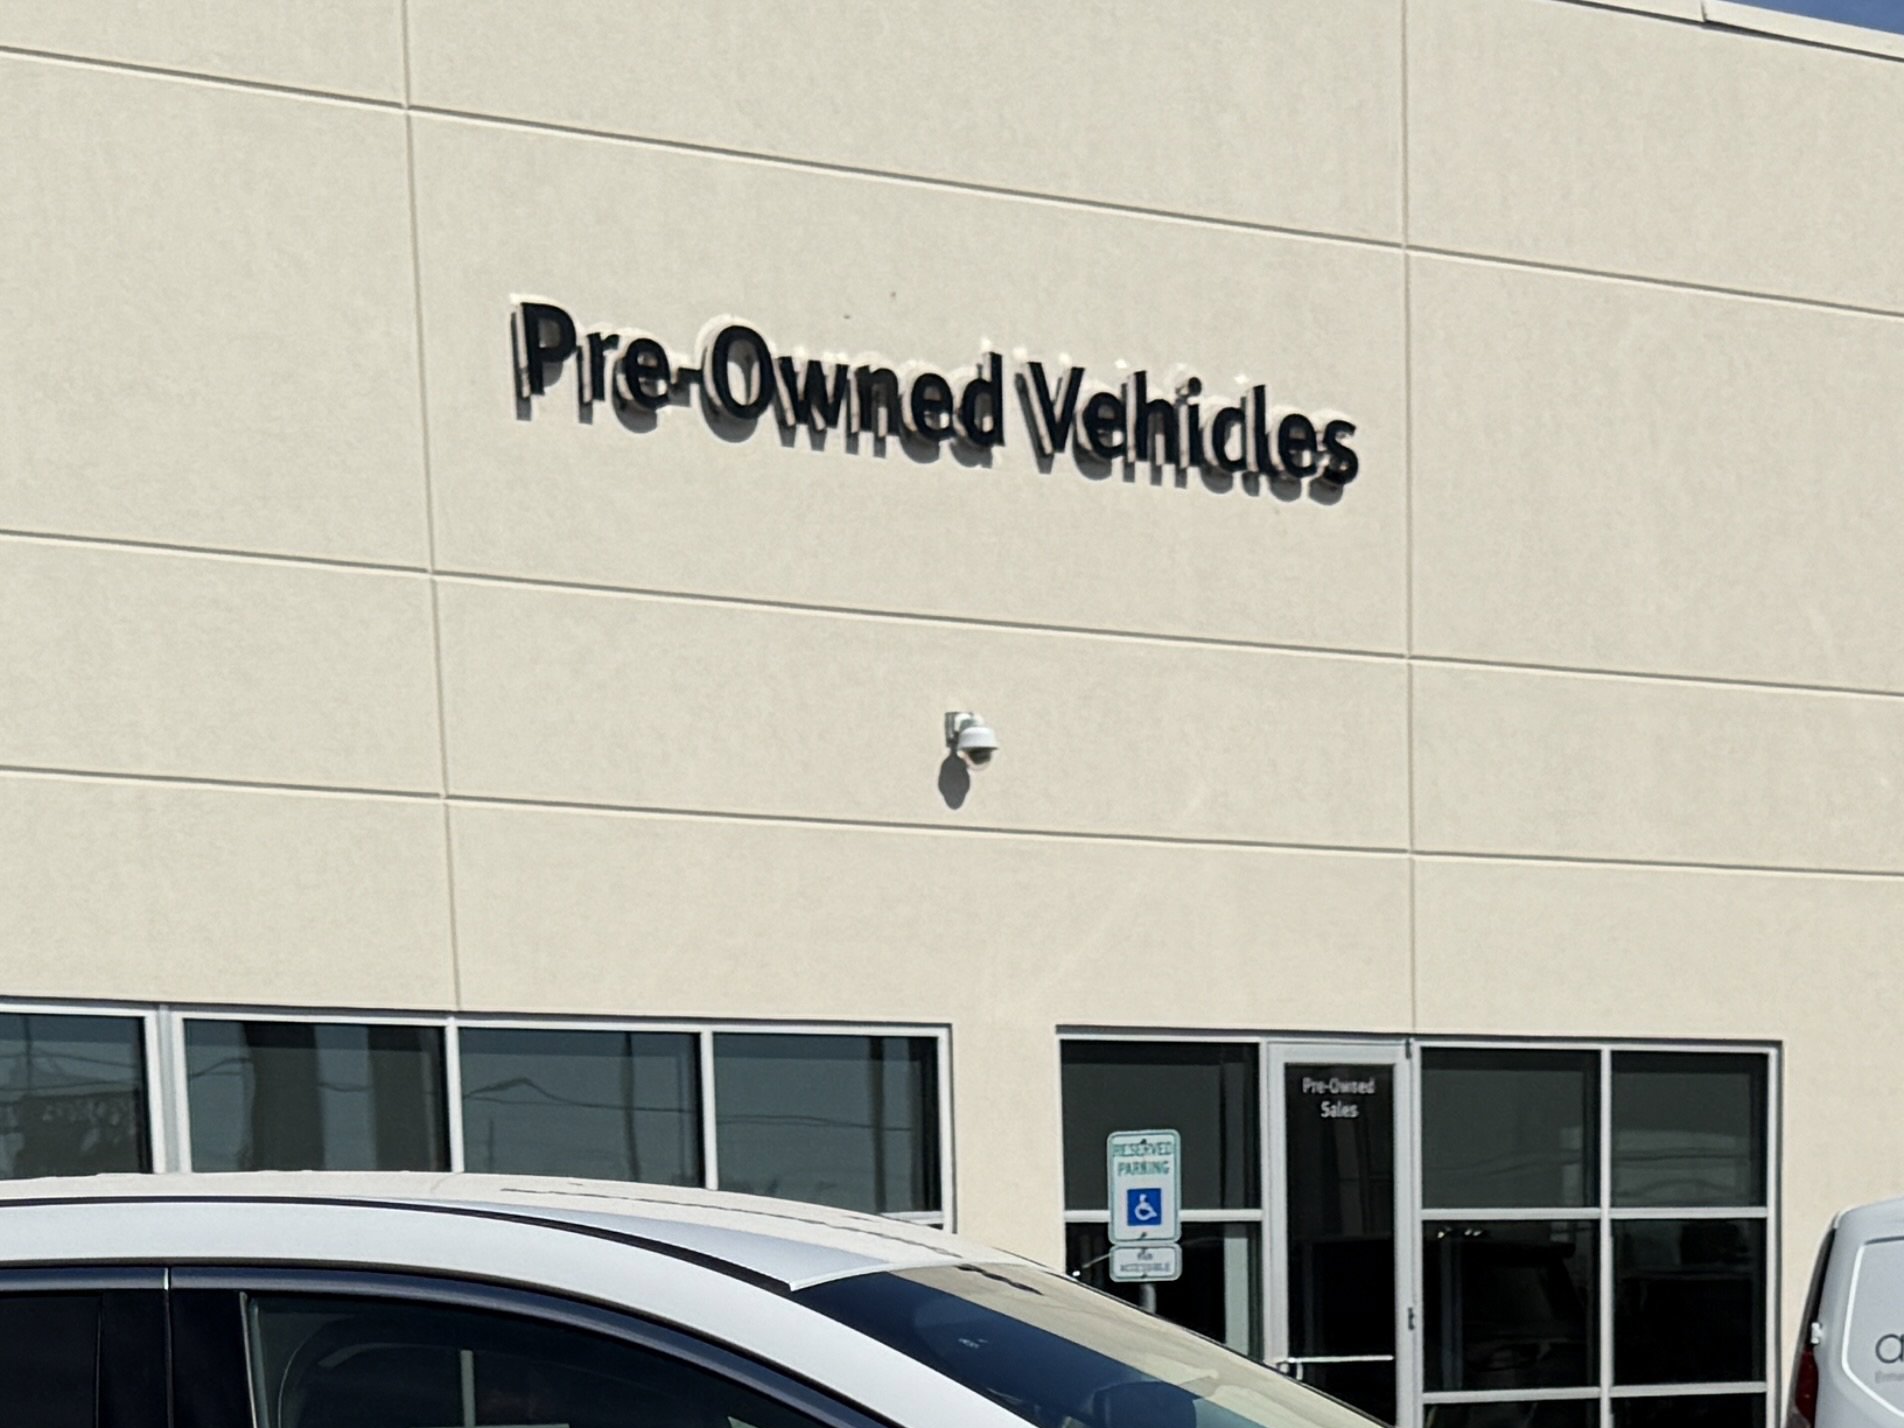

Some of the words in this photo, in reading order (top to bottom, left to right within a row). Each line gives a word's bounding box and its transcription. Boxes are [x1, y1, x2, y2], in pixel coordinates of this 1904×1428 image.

[510, 298, 1006, 458] Pre-Owned
[1014, 356, 1360, 496] Vehicles
[1320, 1101, 1359, 1118] Sales
[1117, 1160, 1170, 1177] PARKING
